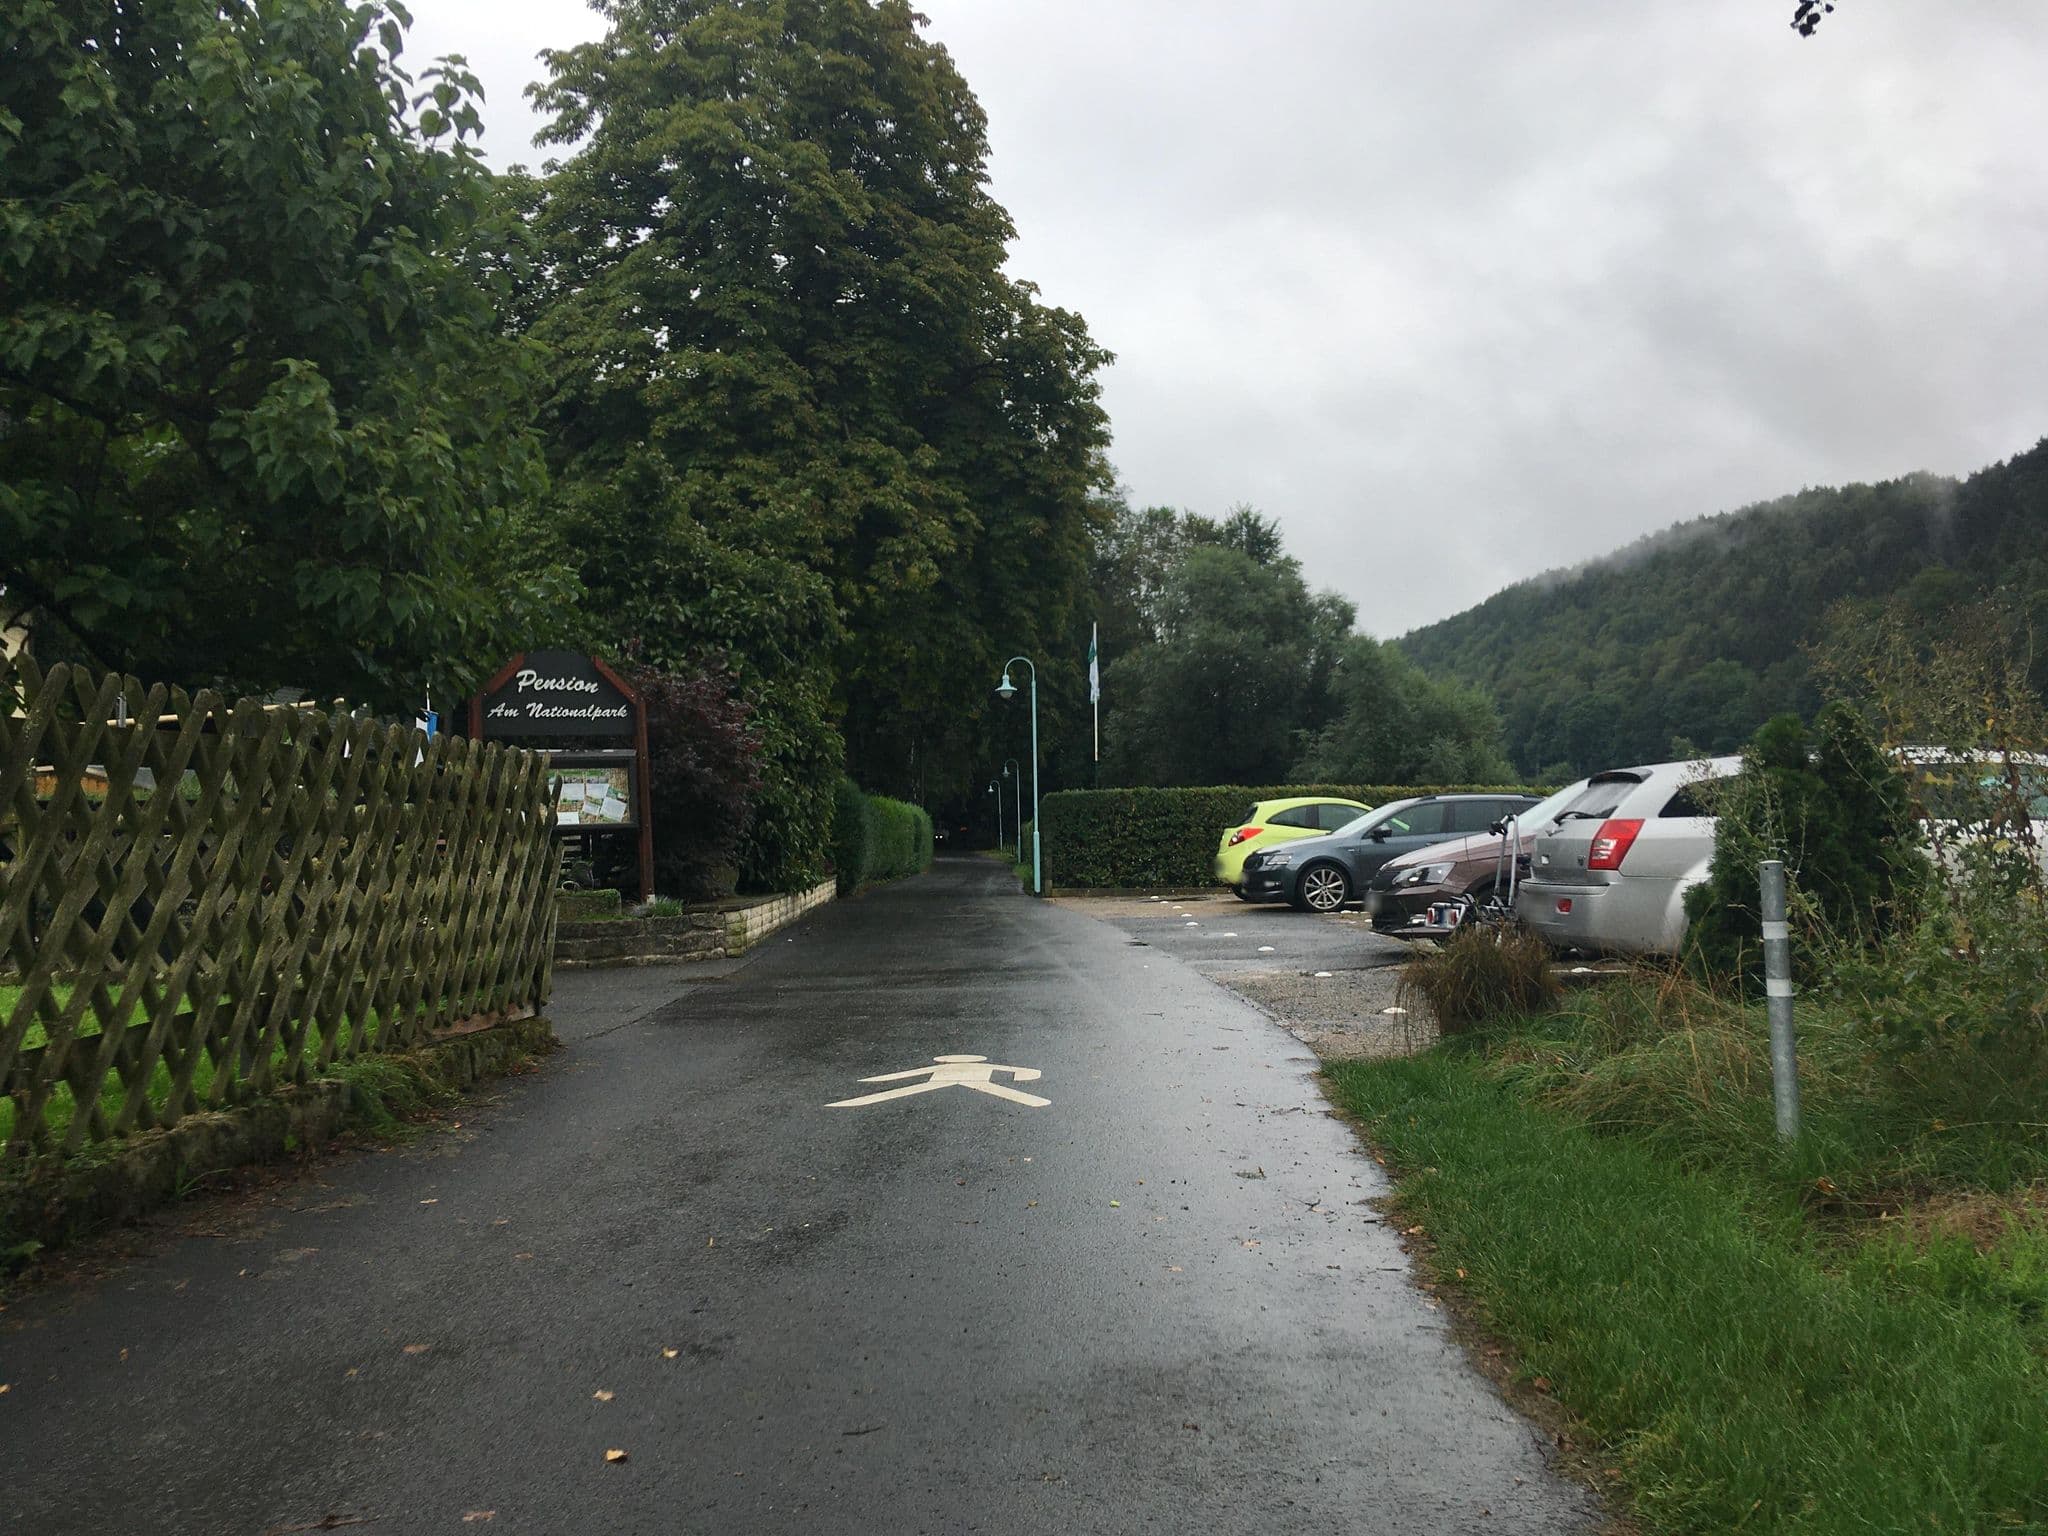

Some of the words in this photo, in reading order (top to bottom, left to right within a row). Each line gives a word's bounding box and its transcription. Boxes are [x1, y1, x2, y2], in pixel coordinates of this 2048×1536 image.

[516, 669, 599, 694] Pension
[487, 702, 520, 718] Am
[525, 702, 629, 721] Nationalpark
